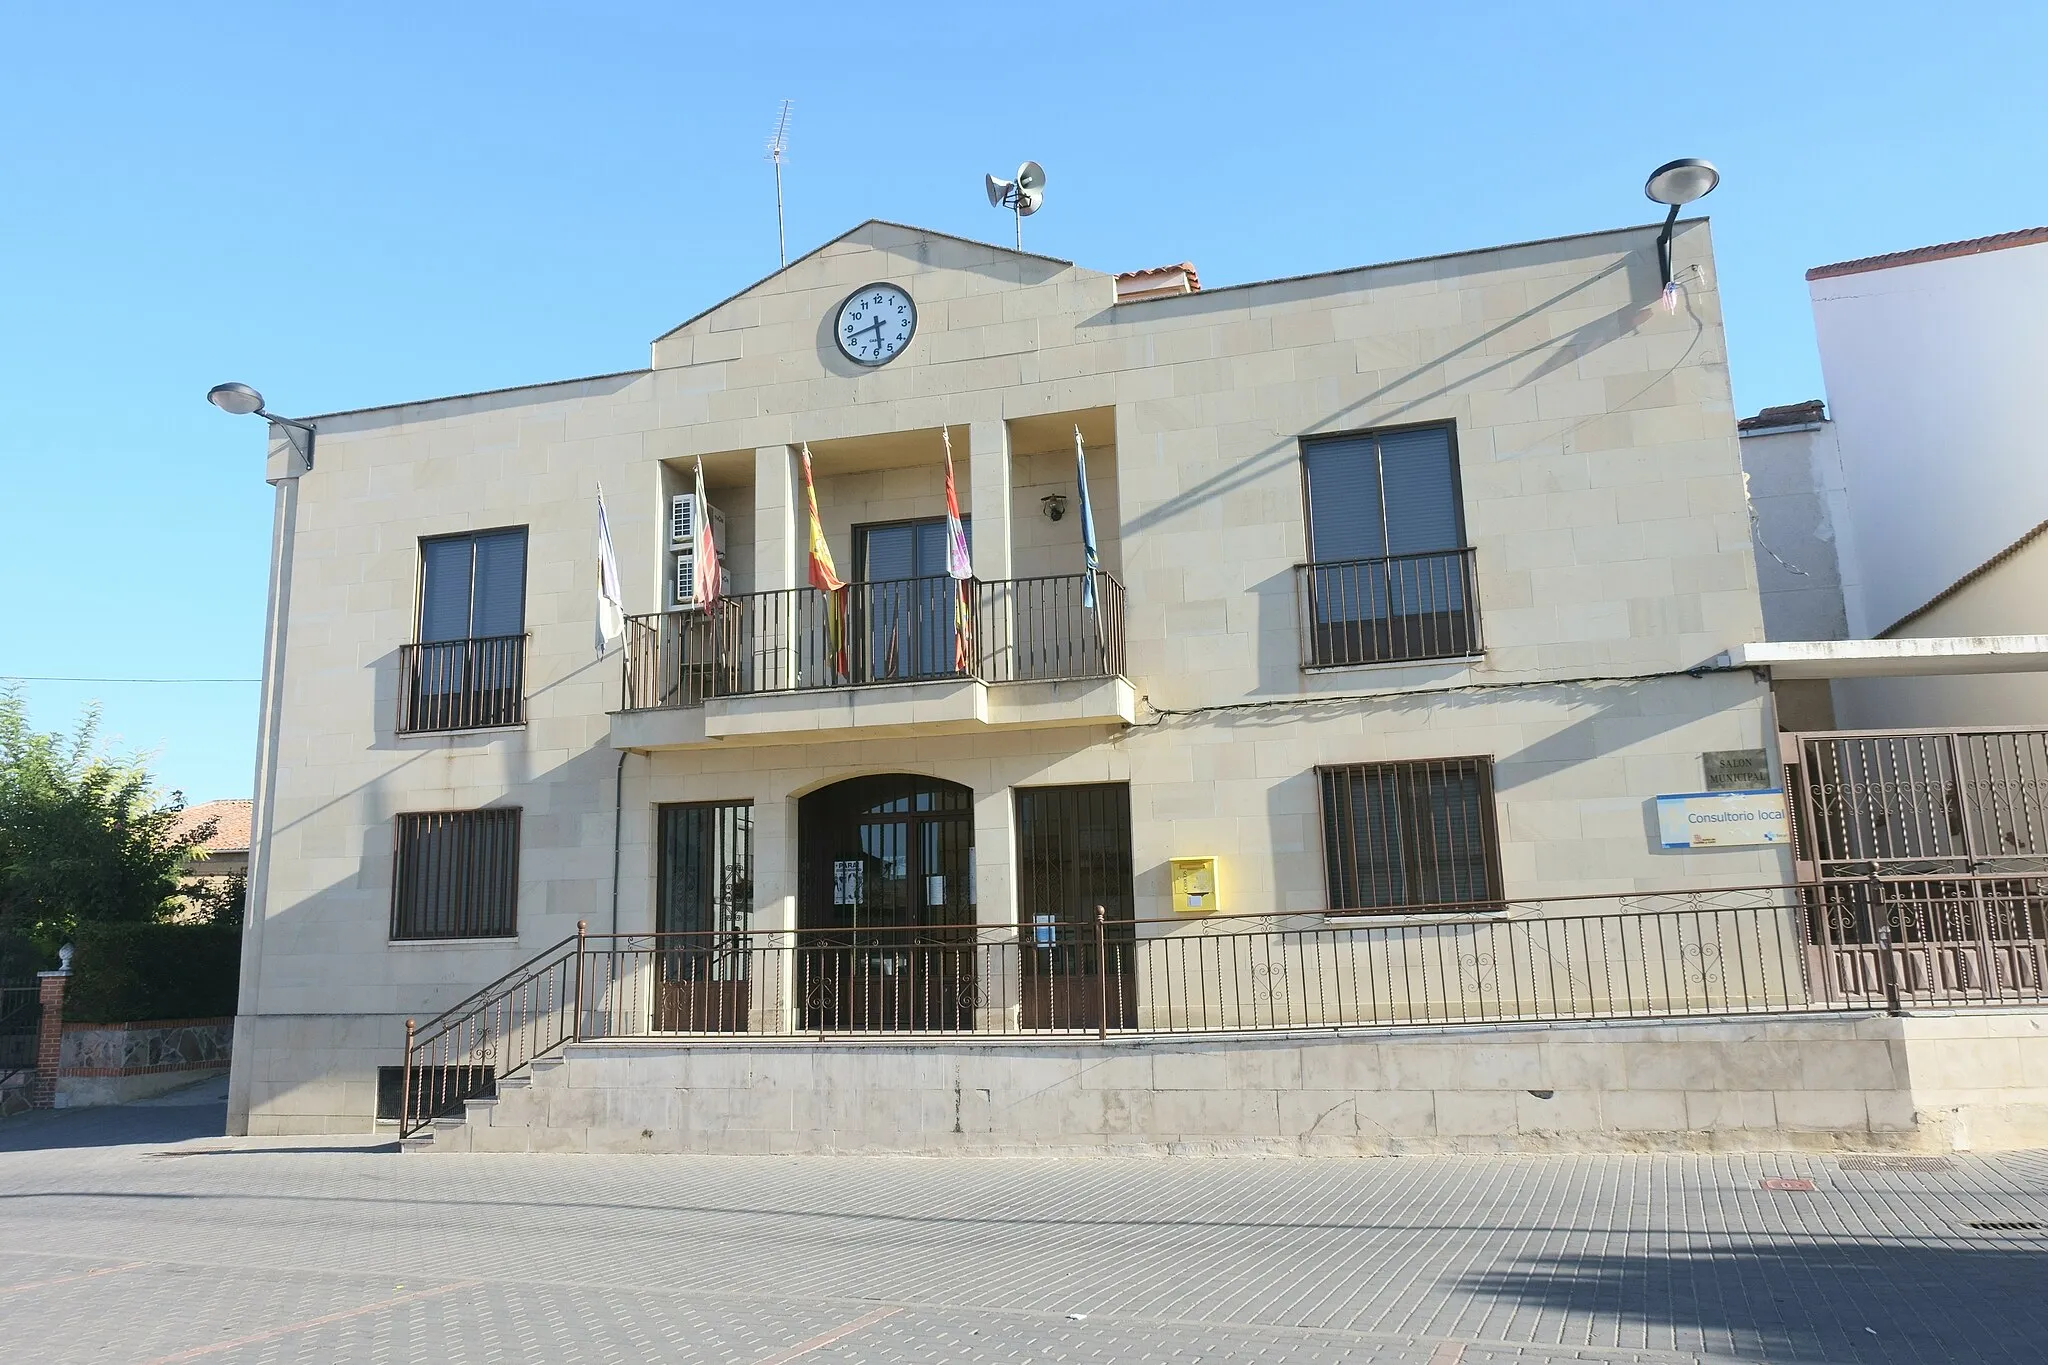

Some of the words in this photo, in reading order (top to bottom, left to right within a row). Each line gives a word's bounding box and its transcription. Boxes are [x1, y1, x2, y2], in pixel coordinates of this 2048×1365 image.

[873, 296, 882, 304] 12
[861, 302, 868, 310] 11
[852, 312, 862, 320] 10
[851, 338, 857, 346] 8
[861, 346, 867, 354] 7
[887, 343, 893, 351] 5
[1719, 758, 1752, 768] SALON
[1710, 772, 1766, 784] MUNICIPAL
[1688, 811, 1754, 823] Consultorio
[1758, 809, 1785, 820] local
